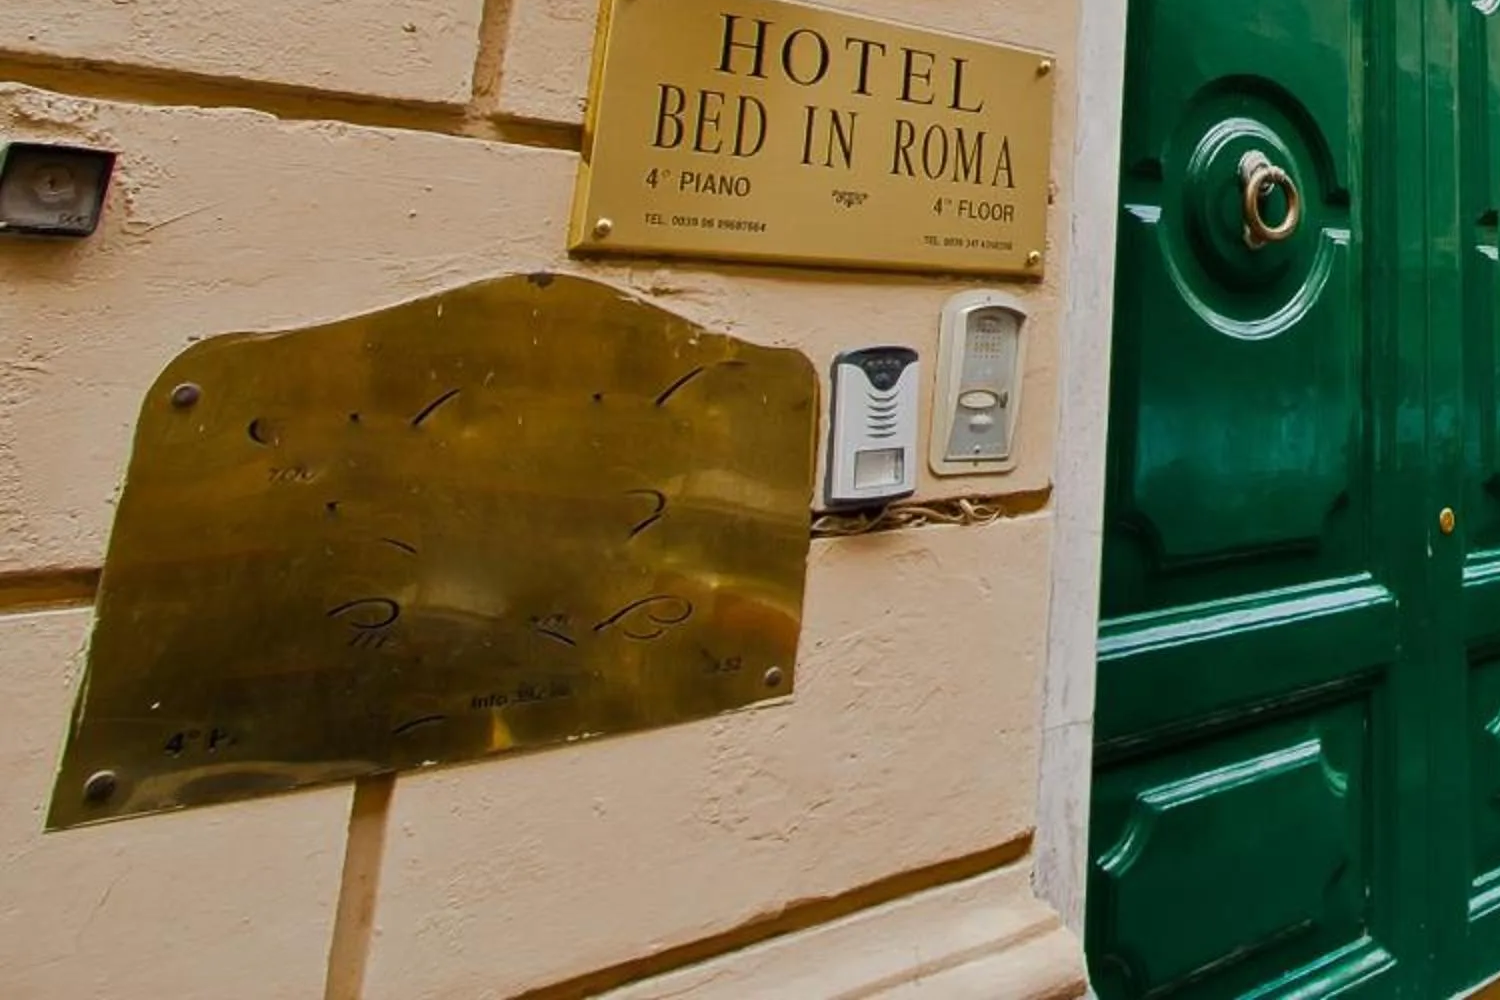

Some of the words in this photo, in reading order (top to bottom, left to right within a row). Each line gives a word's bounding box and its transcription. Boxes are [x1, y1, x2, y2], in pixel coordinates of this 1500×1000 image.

[715, 13, 985, 113] HOTEL
[650, 83, 768, 159] BED
[799, 104, 859, 170] IN
[889, 119, 1017, 189] ROMA
[679, 170, 751, 198] PIANO
[958, 199, 1016, 222] FLOOR
